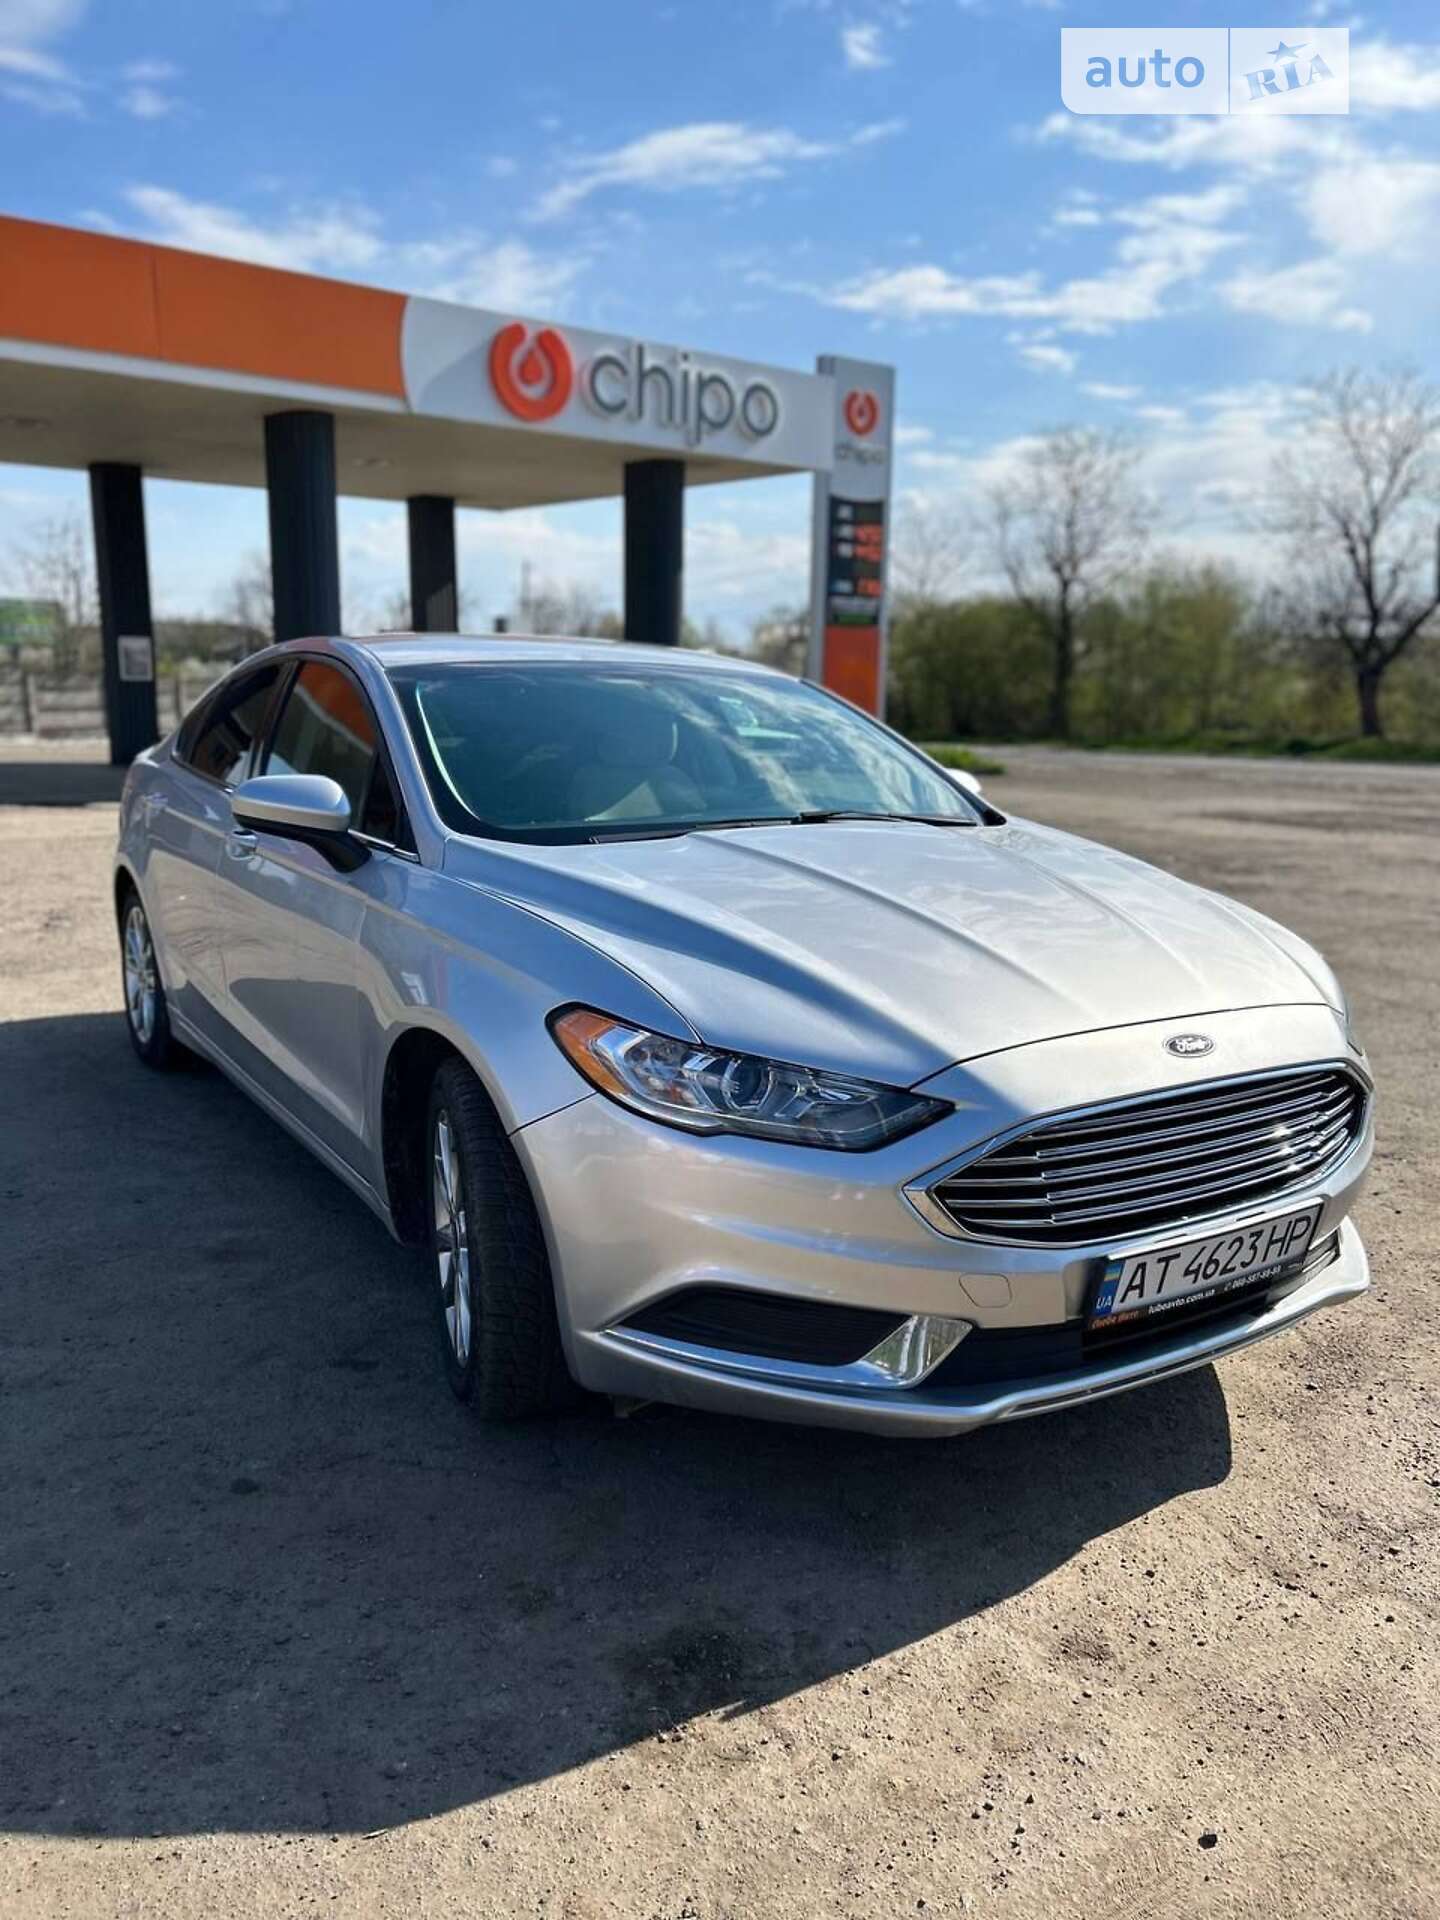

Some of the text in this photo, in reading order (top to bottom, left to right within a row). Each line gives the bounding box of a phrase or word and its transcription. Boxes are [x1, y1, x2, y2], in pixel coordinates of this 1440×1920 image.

[590, 344, 778, 442] chipo
[1096, 1295, 1112, 1309] UA
[1121, 1254, 1180, 1302] AT
[1184, 1230, 1260, 1283] 4623
[1262, 1216, 1311, 1261] HP
